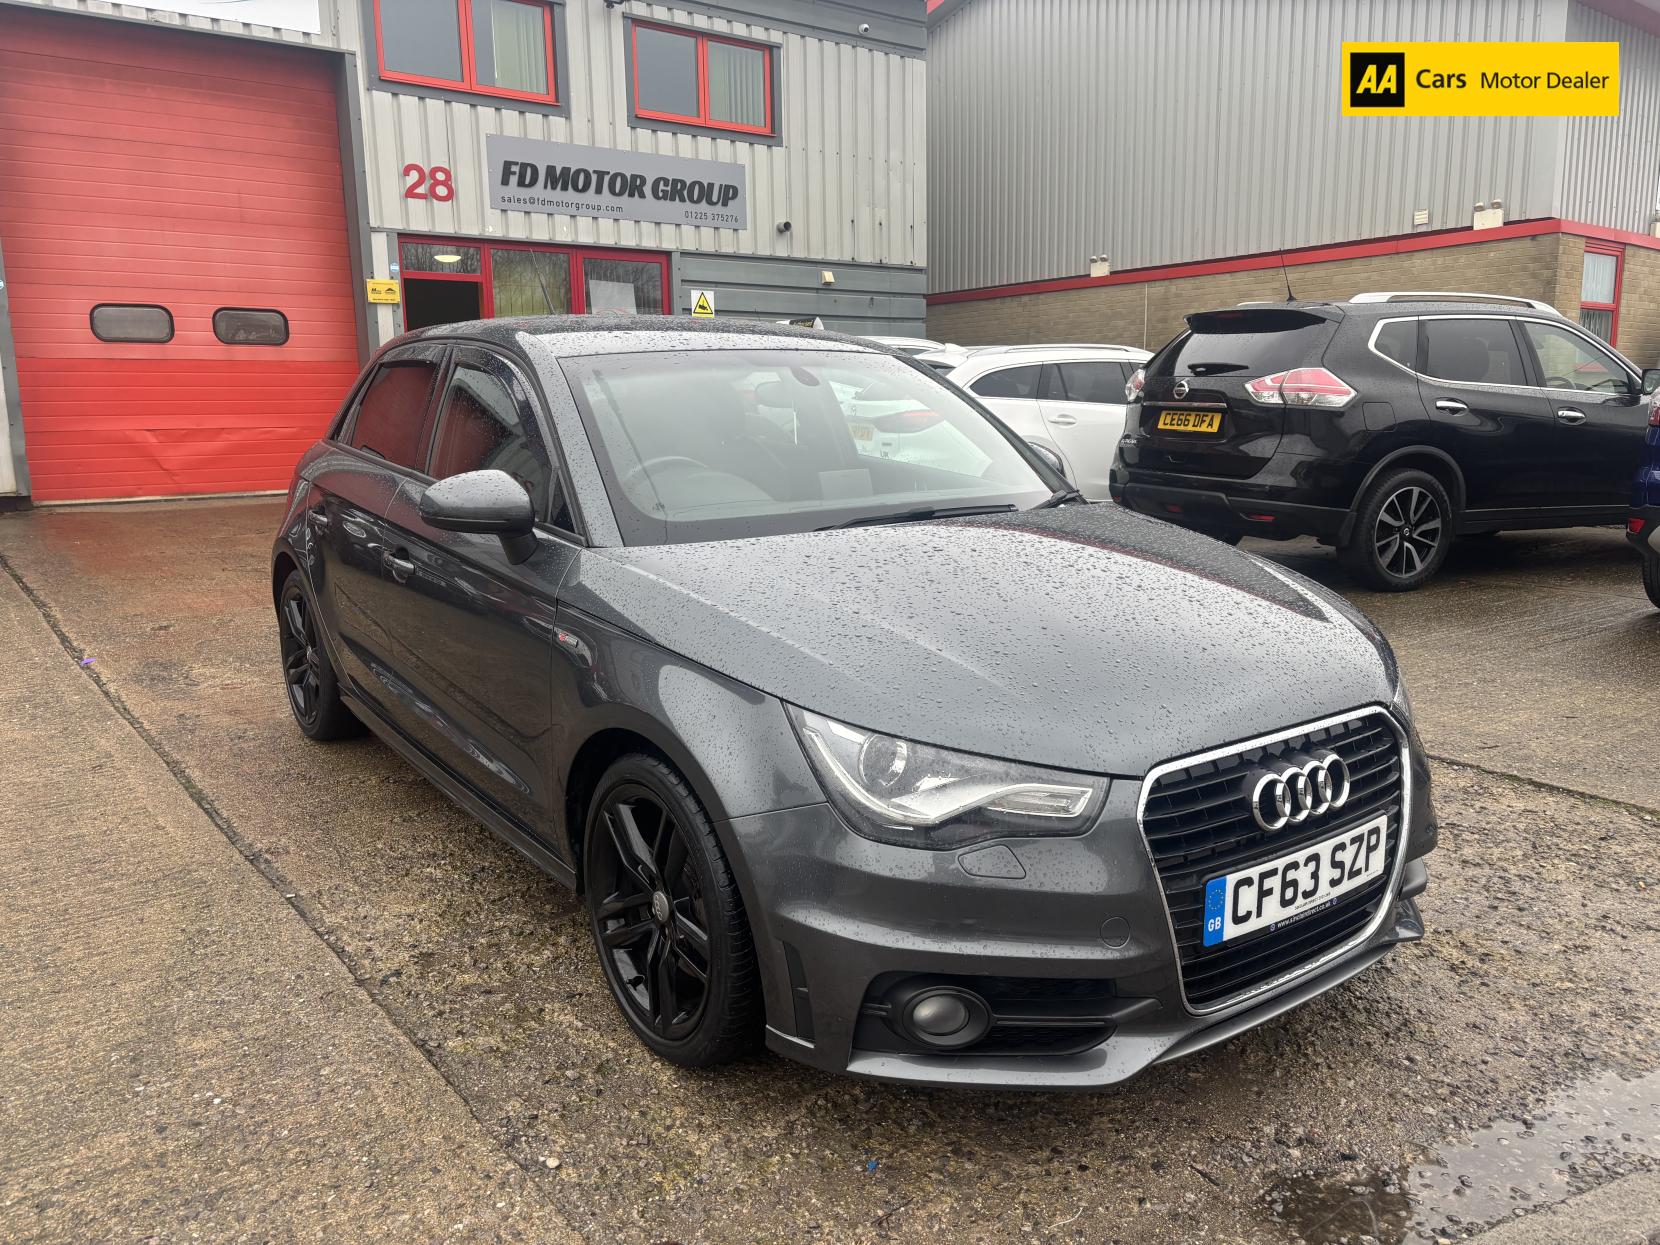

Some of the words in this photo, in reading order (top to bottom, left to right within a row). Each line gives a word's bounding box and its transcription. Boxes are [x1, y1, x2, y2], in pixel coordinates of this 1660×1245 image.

[402, 163, 455, 202] 28
[500, 159, 539, 188] FD
[543, 165, 647, 199] MOTOR
[651, 176, 739, 207] GROUP
[500, 194, 624, 214] sales@fdmotorgroup.com
[684, 210, 708, 221] 01225
[711, 212, 739, 224] 375276
[1163, 412, 1191, 427] CE66
[1192, 413, 1215, 429] DFA
[1231, 852, 1321, 926] CF63
[1329, 825, 1381, 889] SZP
[1207, 917, 1221, 932] GB
